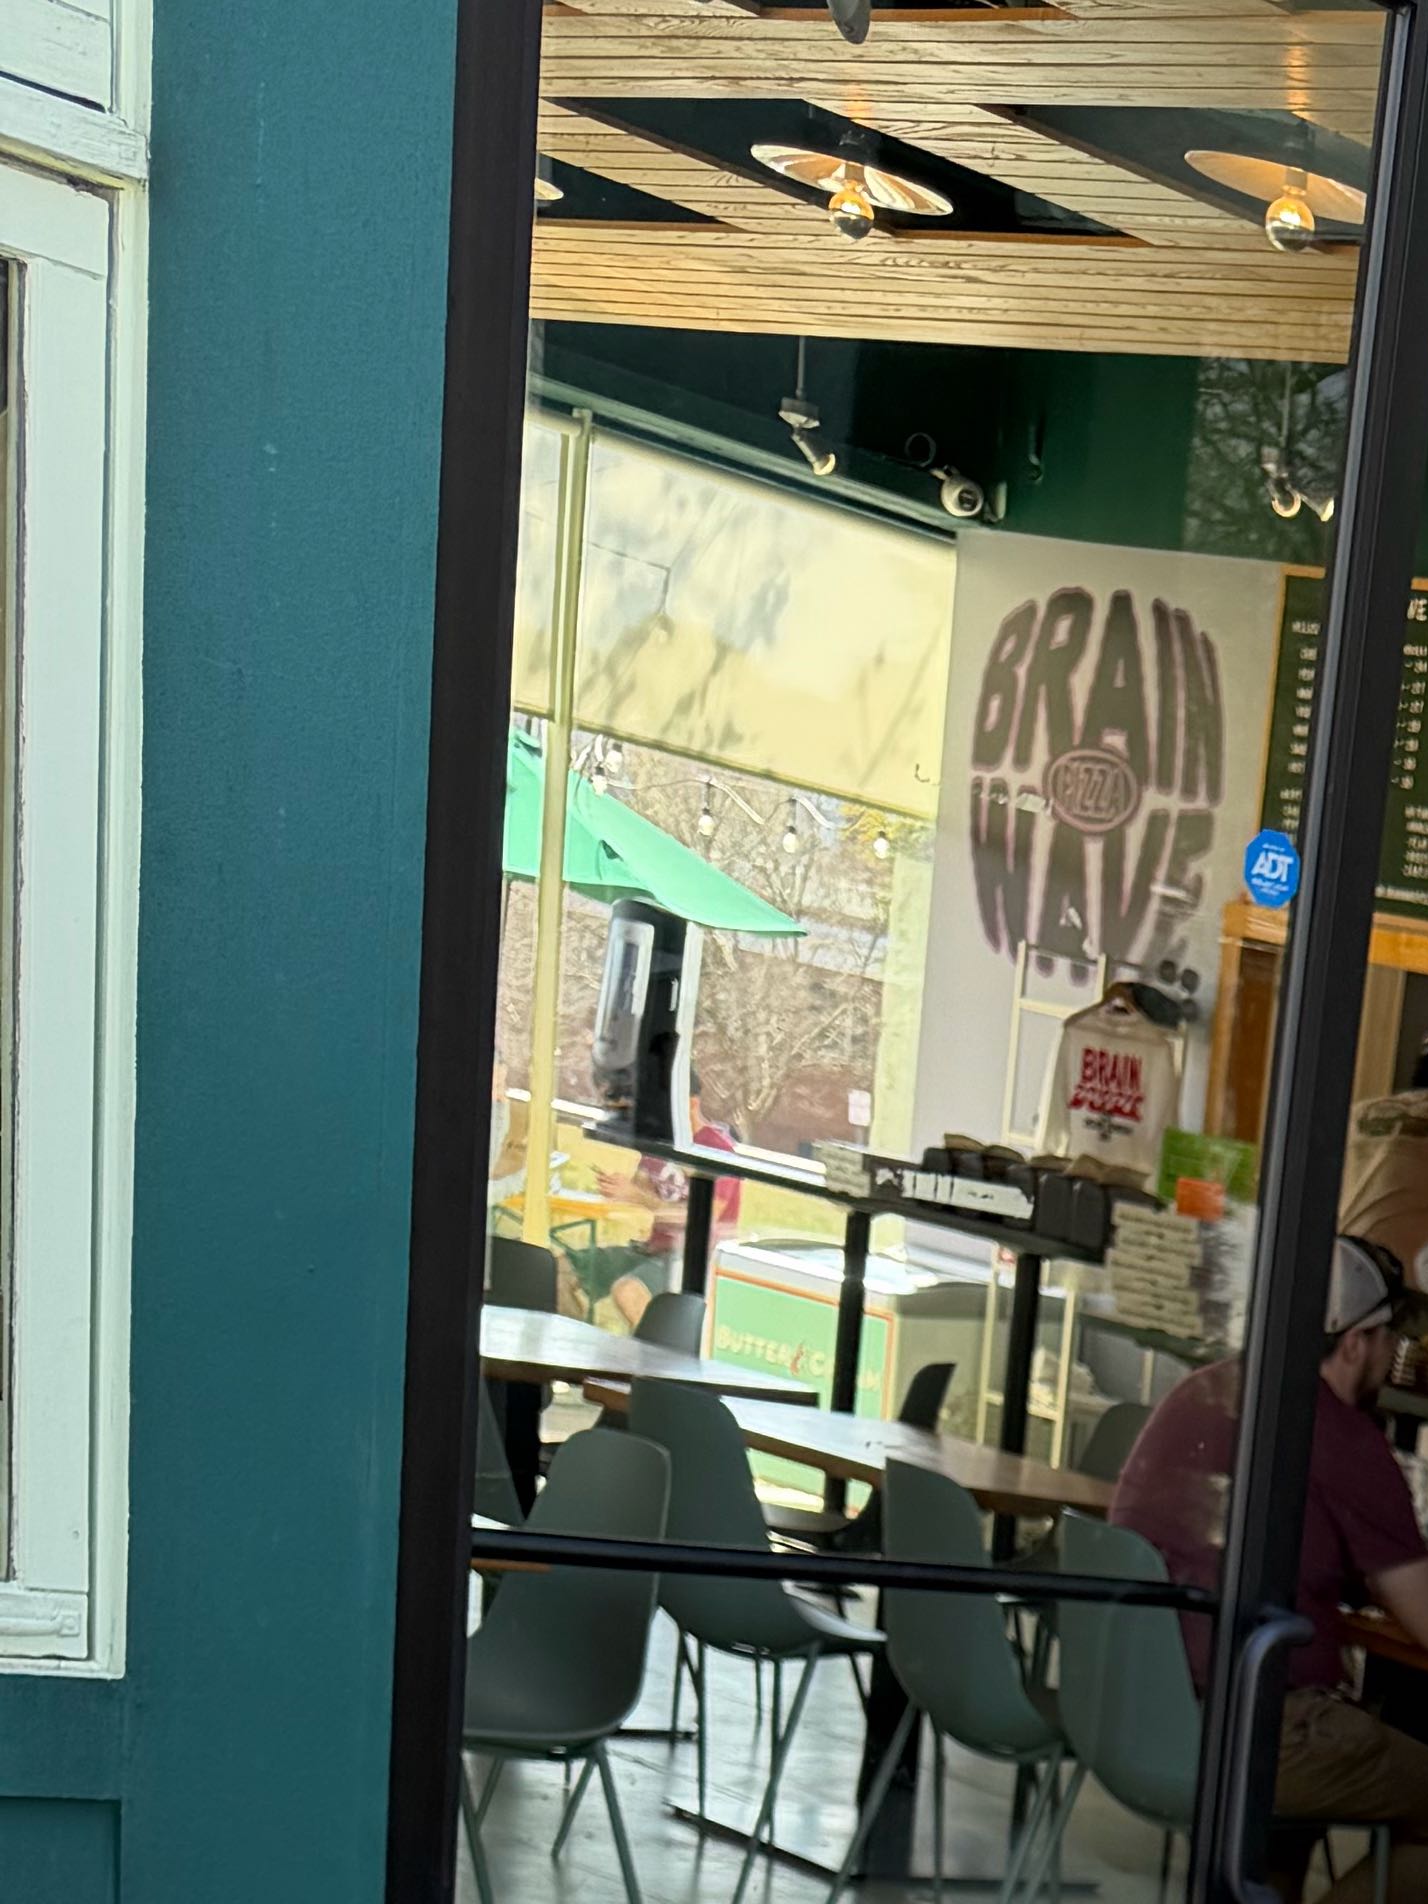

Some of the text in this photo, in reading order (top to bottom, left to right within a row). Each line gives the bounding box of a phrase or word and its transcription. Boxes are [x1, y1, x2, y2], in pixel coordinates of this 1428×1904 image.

[971, 586, 1226, 809] BRAIN
[1054, 761, 1126, 818] PIZZA
[971, 776, 1216, 987] WAVE
[1250, 849, 1295, 883] ADT
